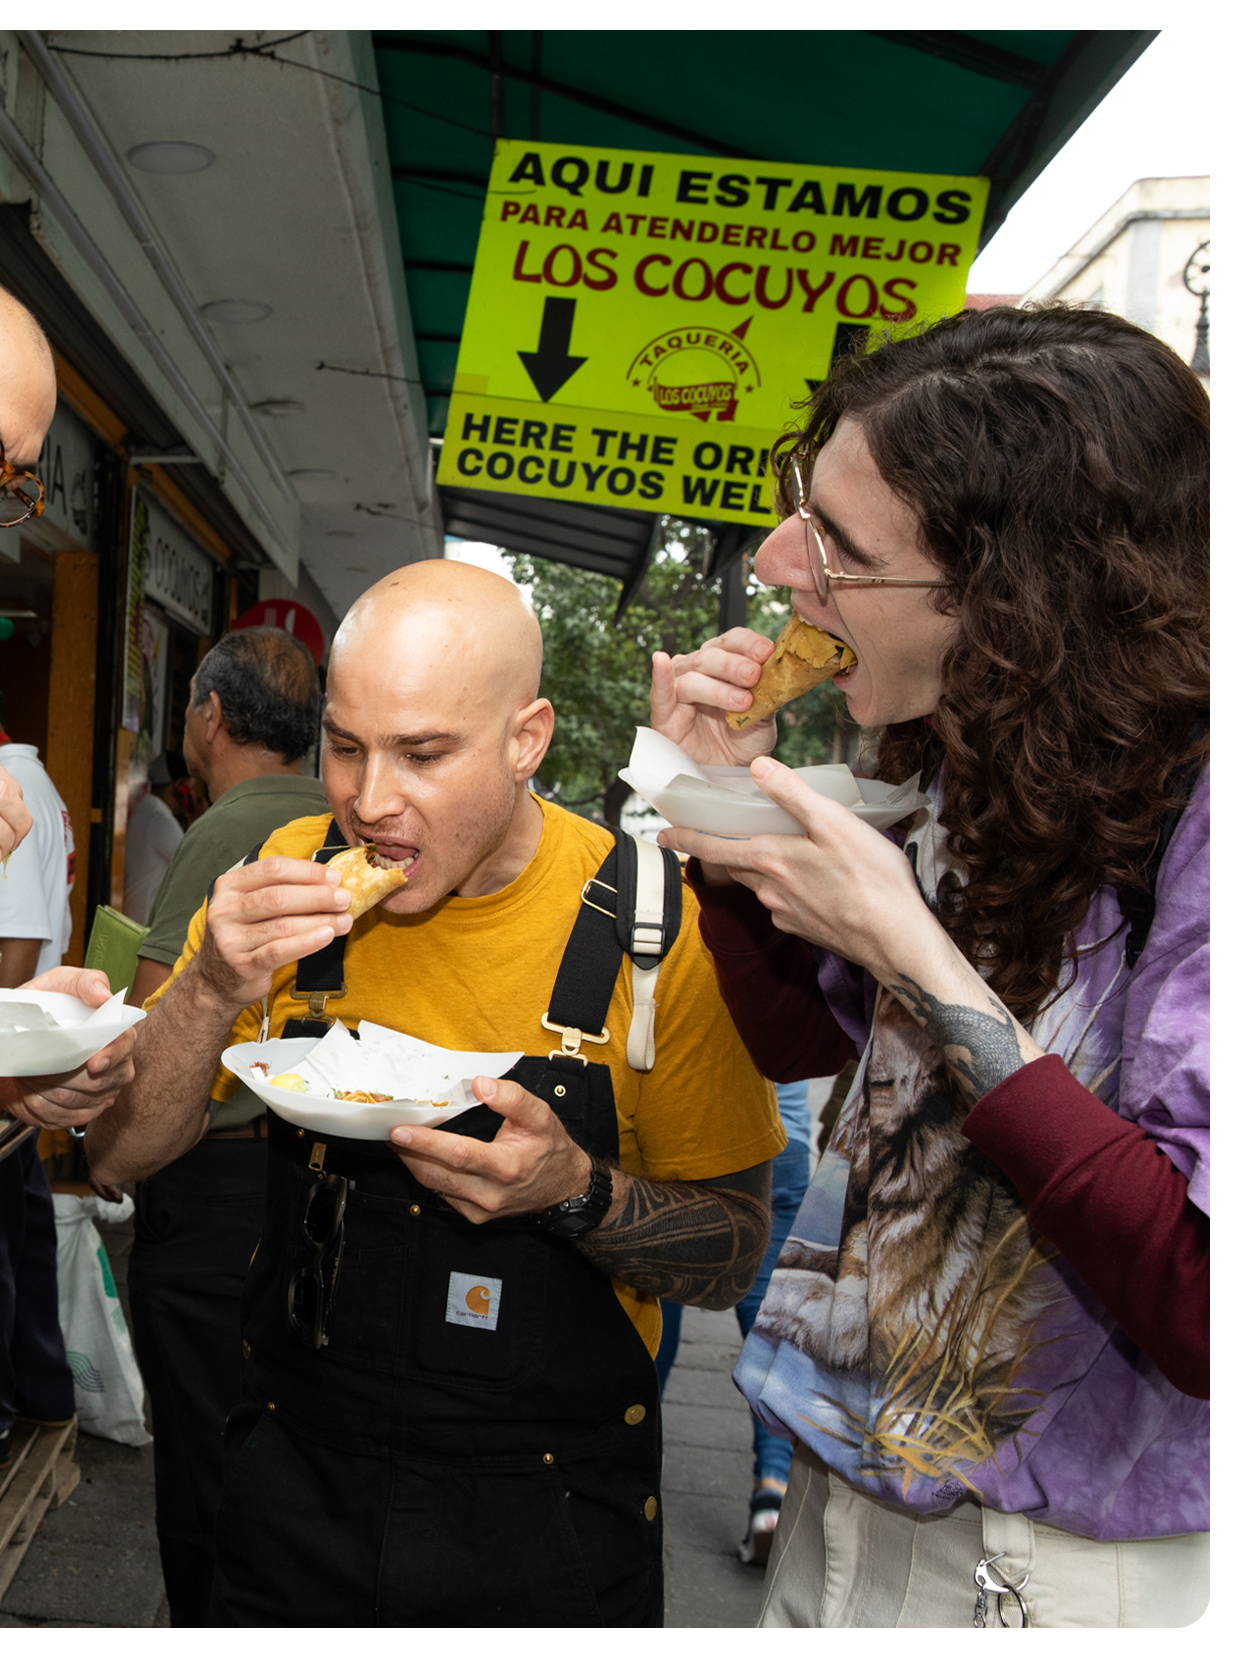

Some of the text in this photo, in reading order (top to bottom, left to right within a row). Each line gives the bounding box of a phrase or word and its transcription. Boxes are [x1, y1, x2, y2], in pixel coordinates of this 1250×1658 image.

[508, 152, 972, 225] AQUI ESTAMOS
[500, 201, 961, 267] PARA ATENDERLO MEJOR
[513, 240, 918, 323] LOS COCUYOS
[639, 332, 750, 375] TAQUERIA
[461, 413, 576, 453] HERE
[592, 428, 678, 466] THE
[457, 448, 665, 500] COCUYOS
